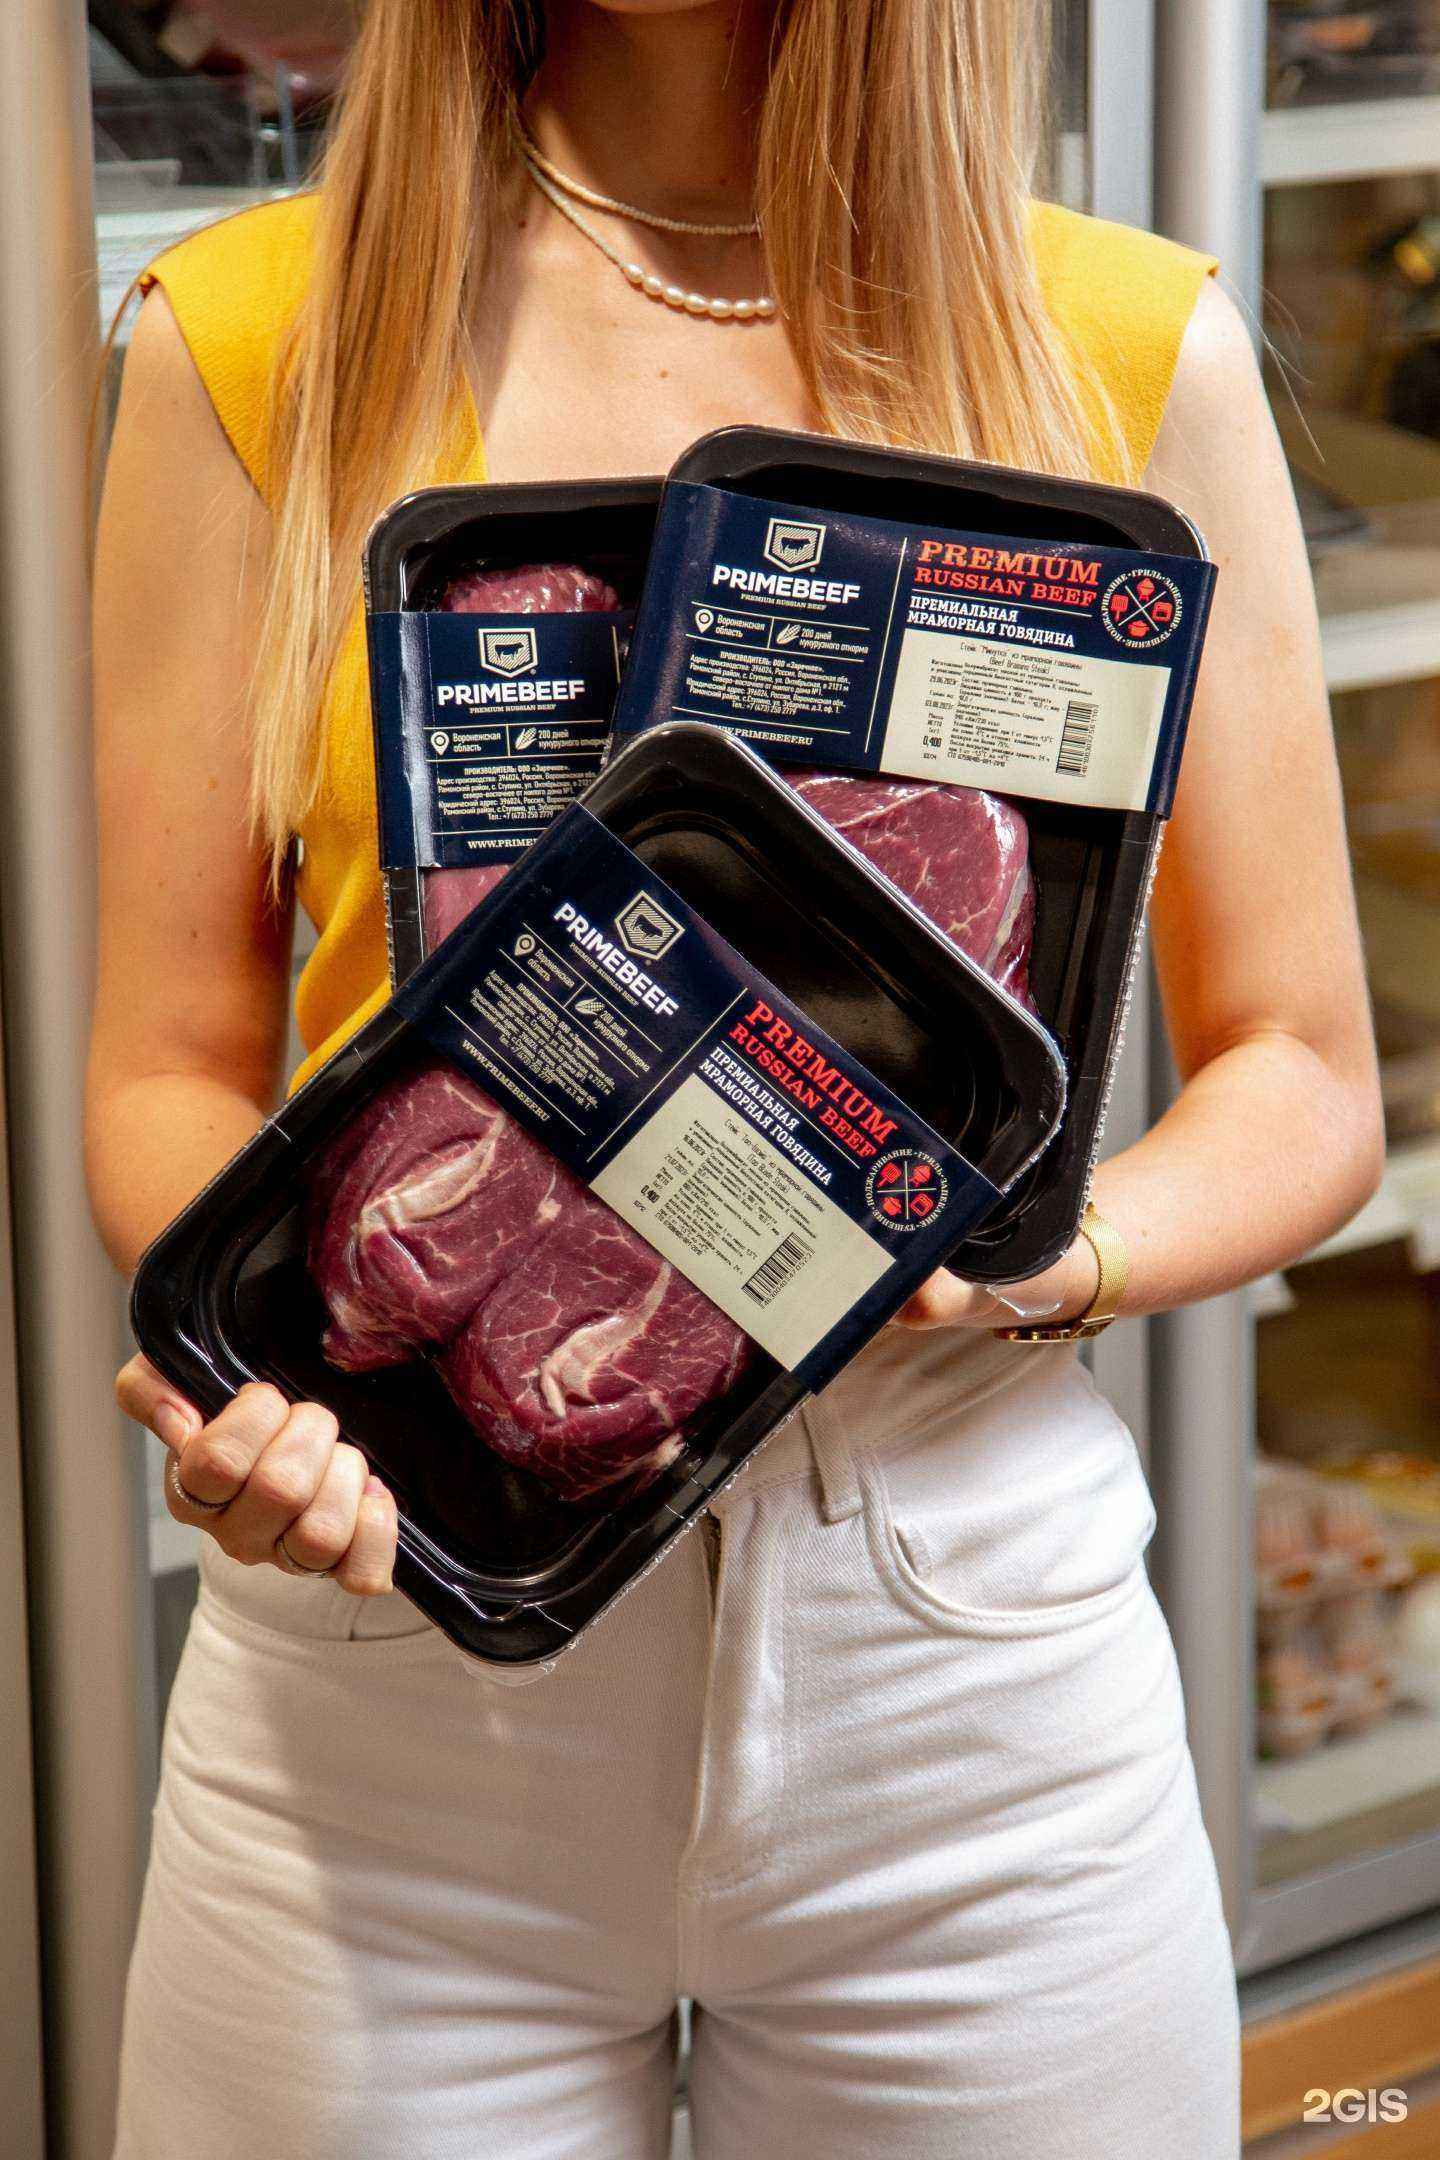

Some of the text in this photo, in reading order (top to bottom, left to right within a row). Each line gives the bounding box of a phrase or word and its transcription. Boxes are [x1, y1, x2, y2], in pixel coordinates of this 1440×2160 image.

[917, 539, 1102, 585] PREMIUM
[1131, 569, 1161, 579] ГРИЛЬ
[712, 564, 860, 604] PRIMEBEEF
[913, 566, 1096, 607] RUSSIAN BEEF
[716, 614, 765, 632] Воронежская
[909, 596, 1018, 623] ПРЕМИАЛЬНАЯ
[715, 625, 743, 638] область
[906, 610, 1076, 648] МРАМОРНАЯ ГОВЯДИНА
[438, 680, 585, 706] PRIMEBEEF
[452, 731, 500, 742] Воронежская
[453, 744, 481, 752] область
[538, 729, 550, 738] 200
[526, 957, 552, 982] область
[533, 948, 576, 988] Воронежская
[554, 903, 679, 1016] PRIMEBEEF
[599, 1010, 628, 1037] 200 дней
[743, 999, 899, 1145] PREMIUM
[709, 1047, 800, 1130] ПРЕМИАЛЬНАЯ
[729, 1024, 877, 1157] RUSSIAN BEEF
[699, 1058, 832, 1185] МРАМОРНАЯ ГОВЯДИНА
